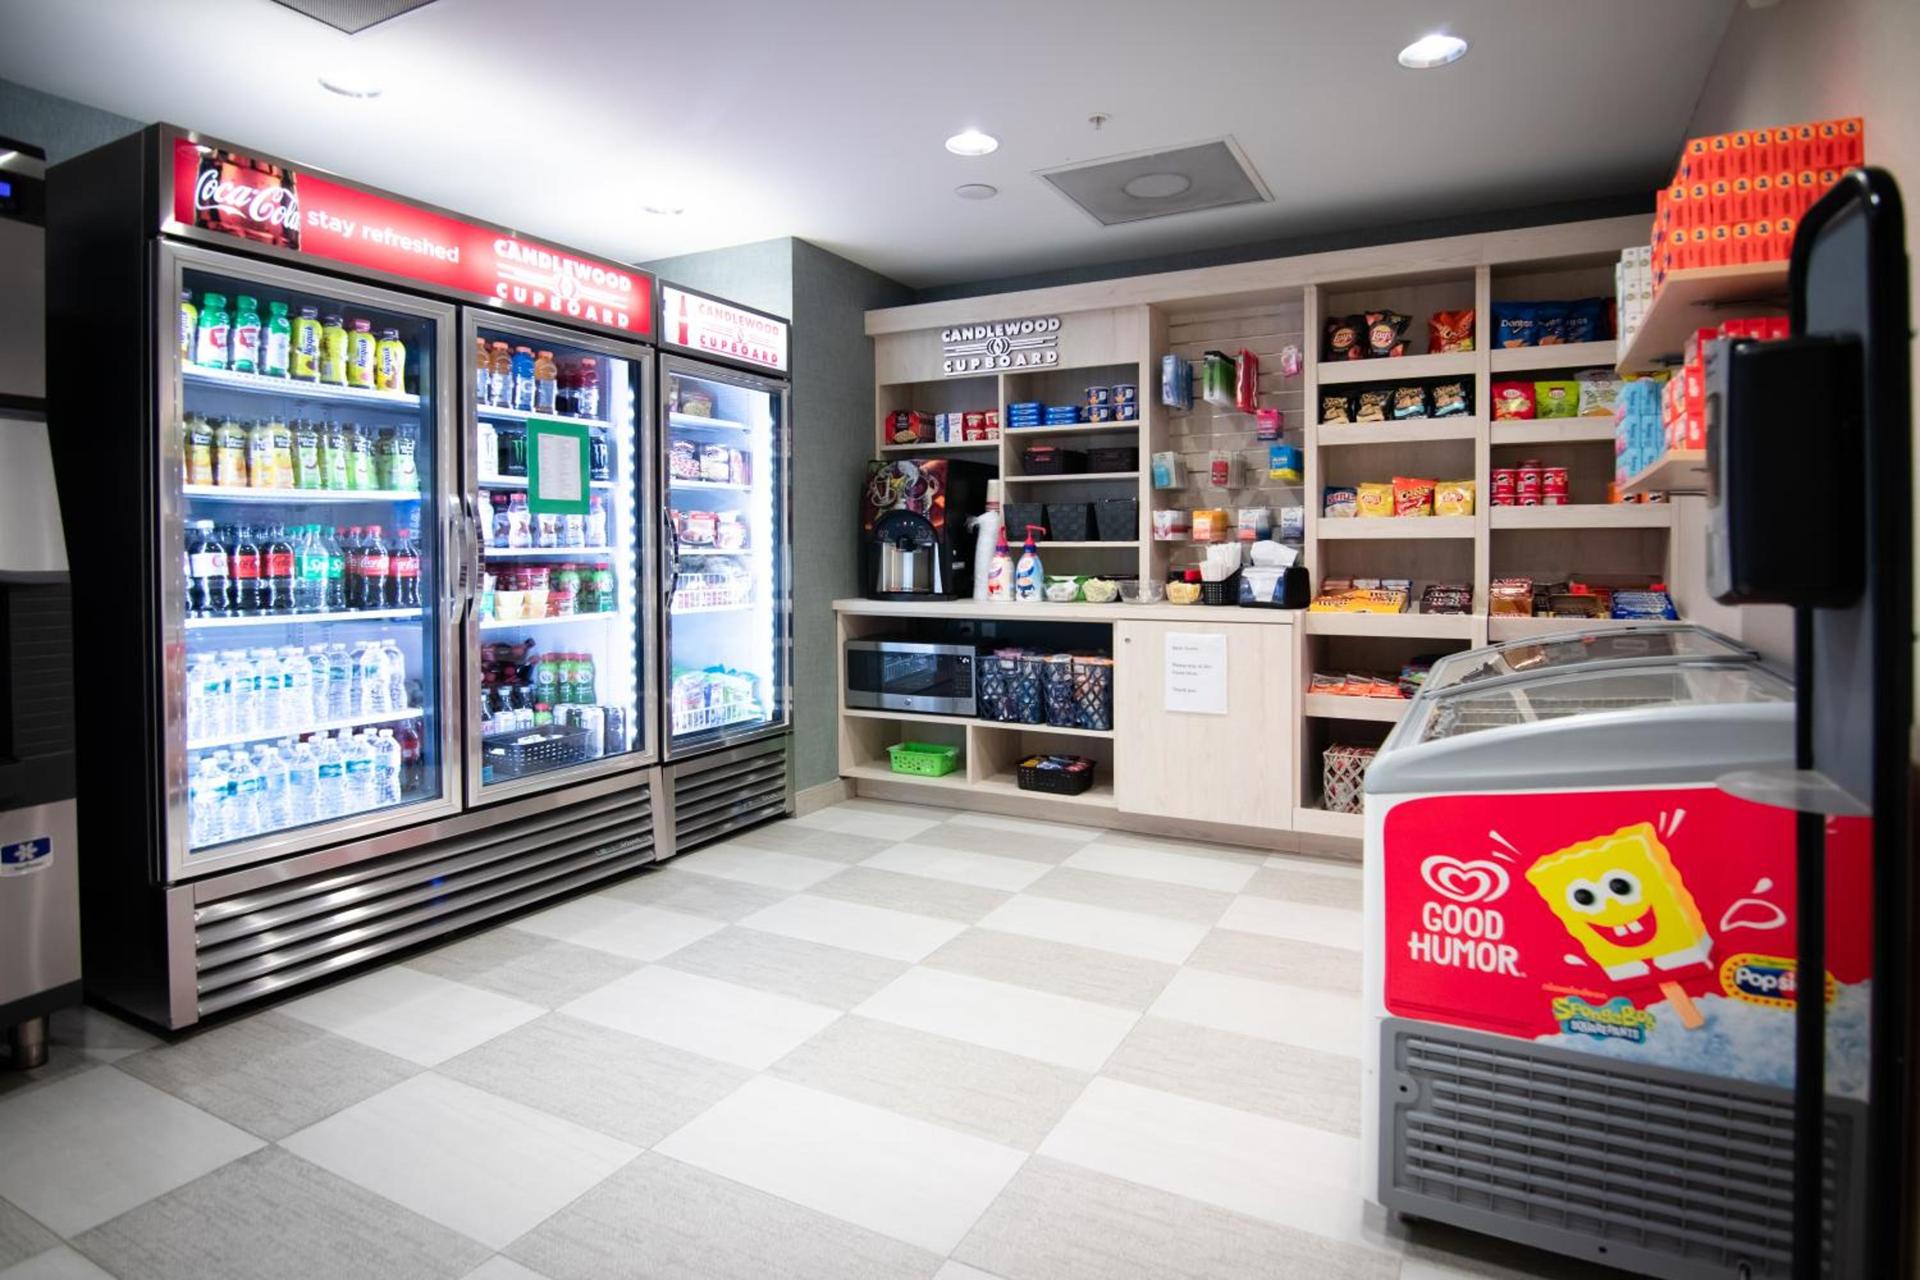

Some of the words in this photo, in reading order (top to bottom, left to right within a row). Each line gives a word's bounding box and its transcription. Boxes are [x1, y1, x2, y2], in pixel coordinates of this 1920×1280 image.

[195, 169, 299, 231] Coca-Cola
[307, 210, 355, 238] stay
[361, 223, 460, 264] refreshed
[493, 238, 632, 292] CANDLEWOOD
[496, 282, 629, 328] CUPBOARD
[698, 303, 779, 336] CANDLEWOOD
[942, 318, 1060, 342] CANDLEWOOD
[1501, 319, 1533, 328] Doritos
[699, 334, 778, 363] CUPBOARD
[943, 351, 1057, 372] CUPBOARD
[1422, 901, 1504, 940] GOOD
[1407, 931, 1521, 977] HUMOR
[1735, 967, 1798, 993] Popsi
